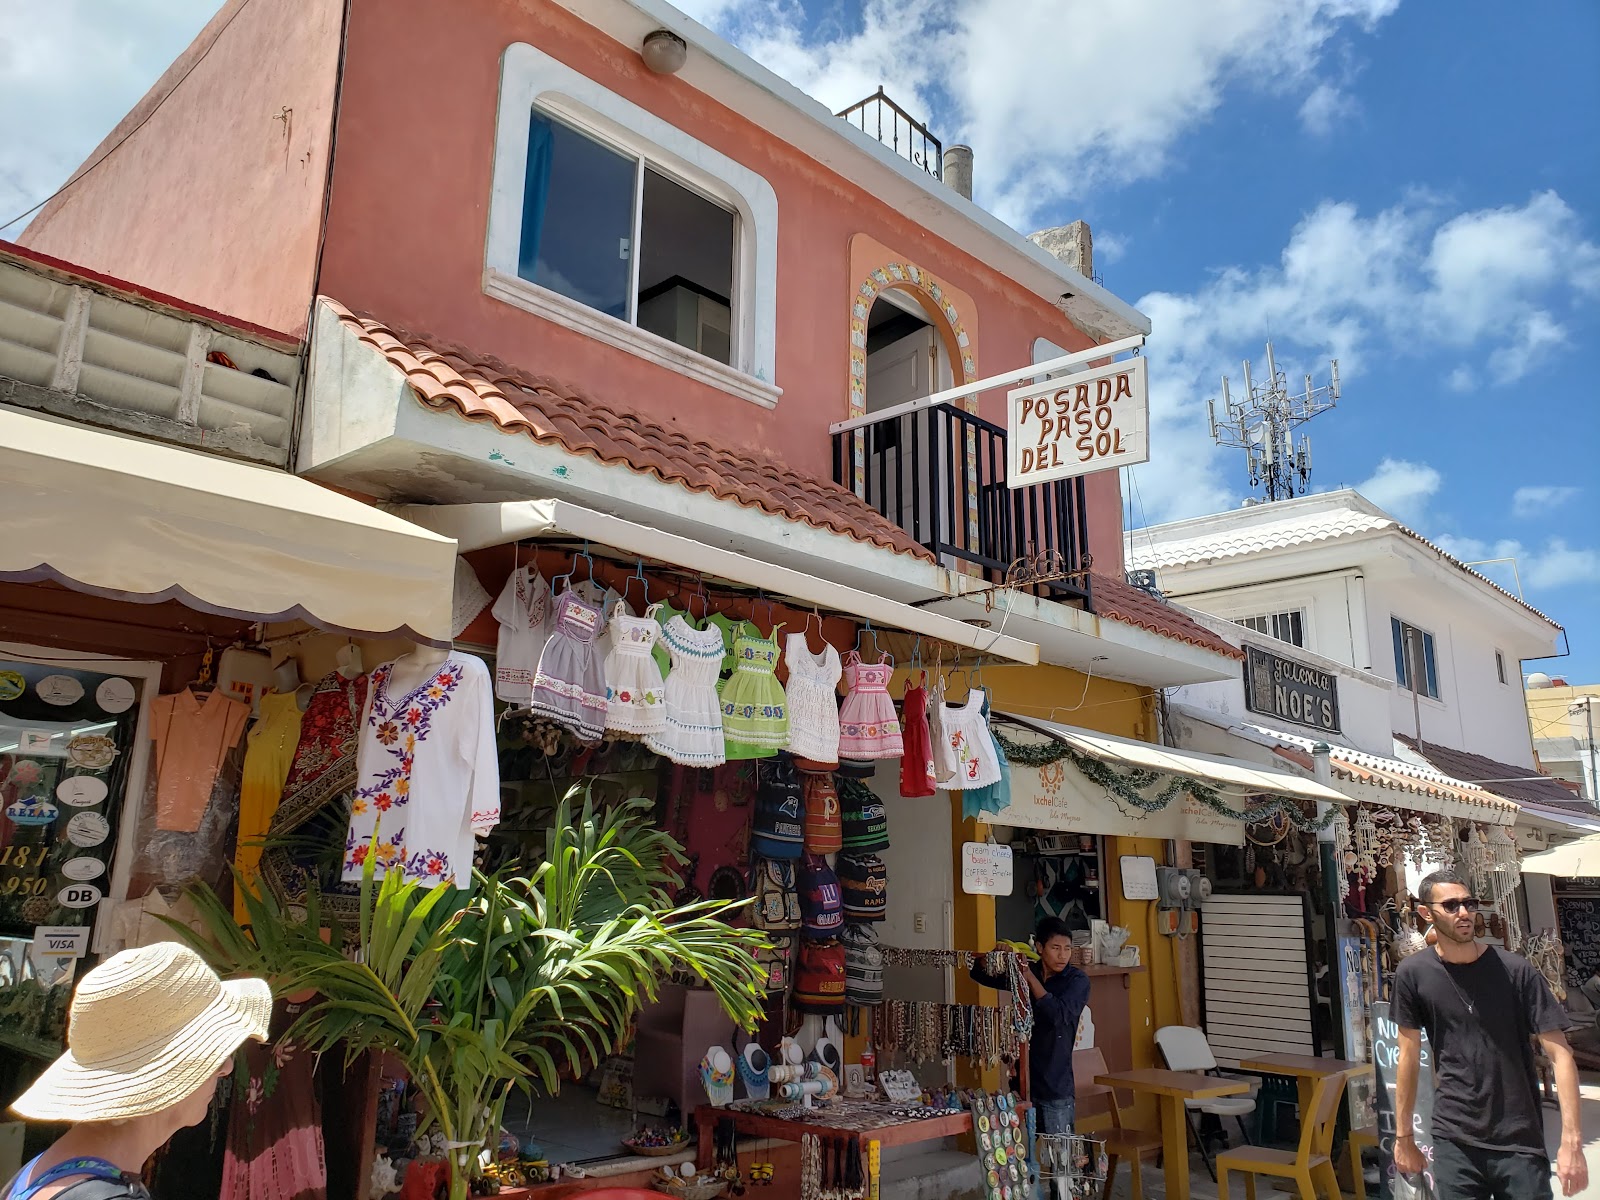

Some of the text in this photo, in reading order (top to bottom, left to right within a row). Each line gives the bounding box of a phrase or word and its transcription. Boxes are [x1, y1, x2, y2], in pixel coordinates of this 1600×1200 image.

[1019, 372, 1132, 425] POSADA
[1037, 404, 1112, 445] PASO
[1020, 427, 1126, 474] DEL SOL
[1275, 684, 1332, 727] NOE'S
[7, 807, 57, 819] RELAX
[67, 890, 93, 902] DB
[864, 897, 885, 906] RAMS
[48, 940, 75, 949] VISA
[1375, 1040, 1430, 1068] Cree
[1380, 1110, 1424, 1134] Ie
